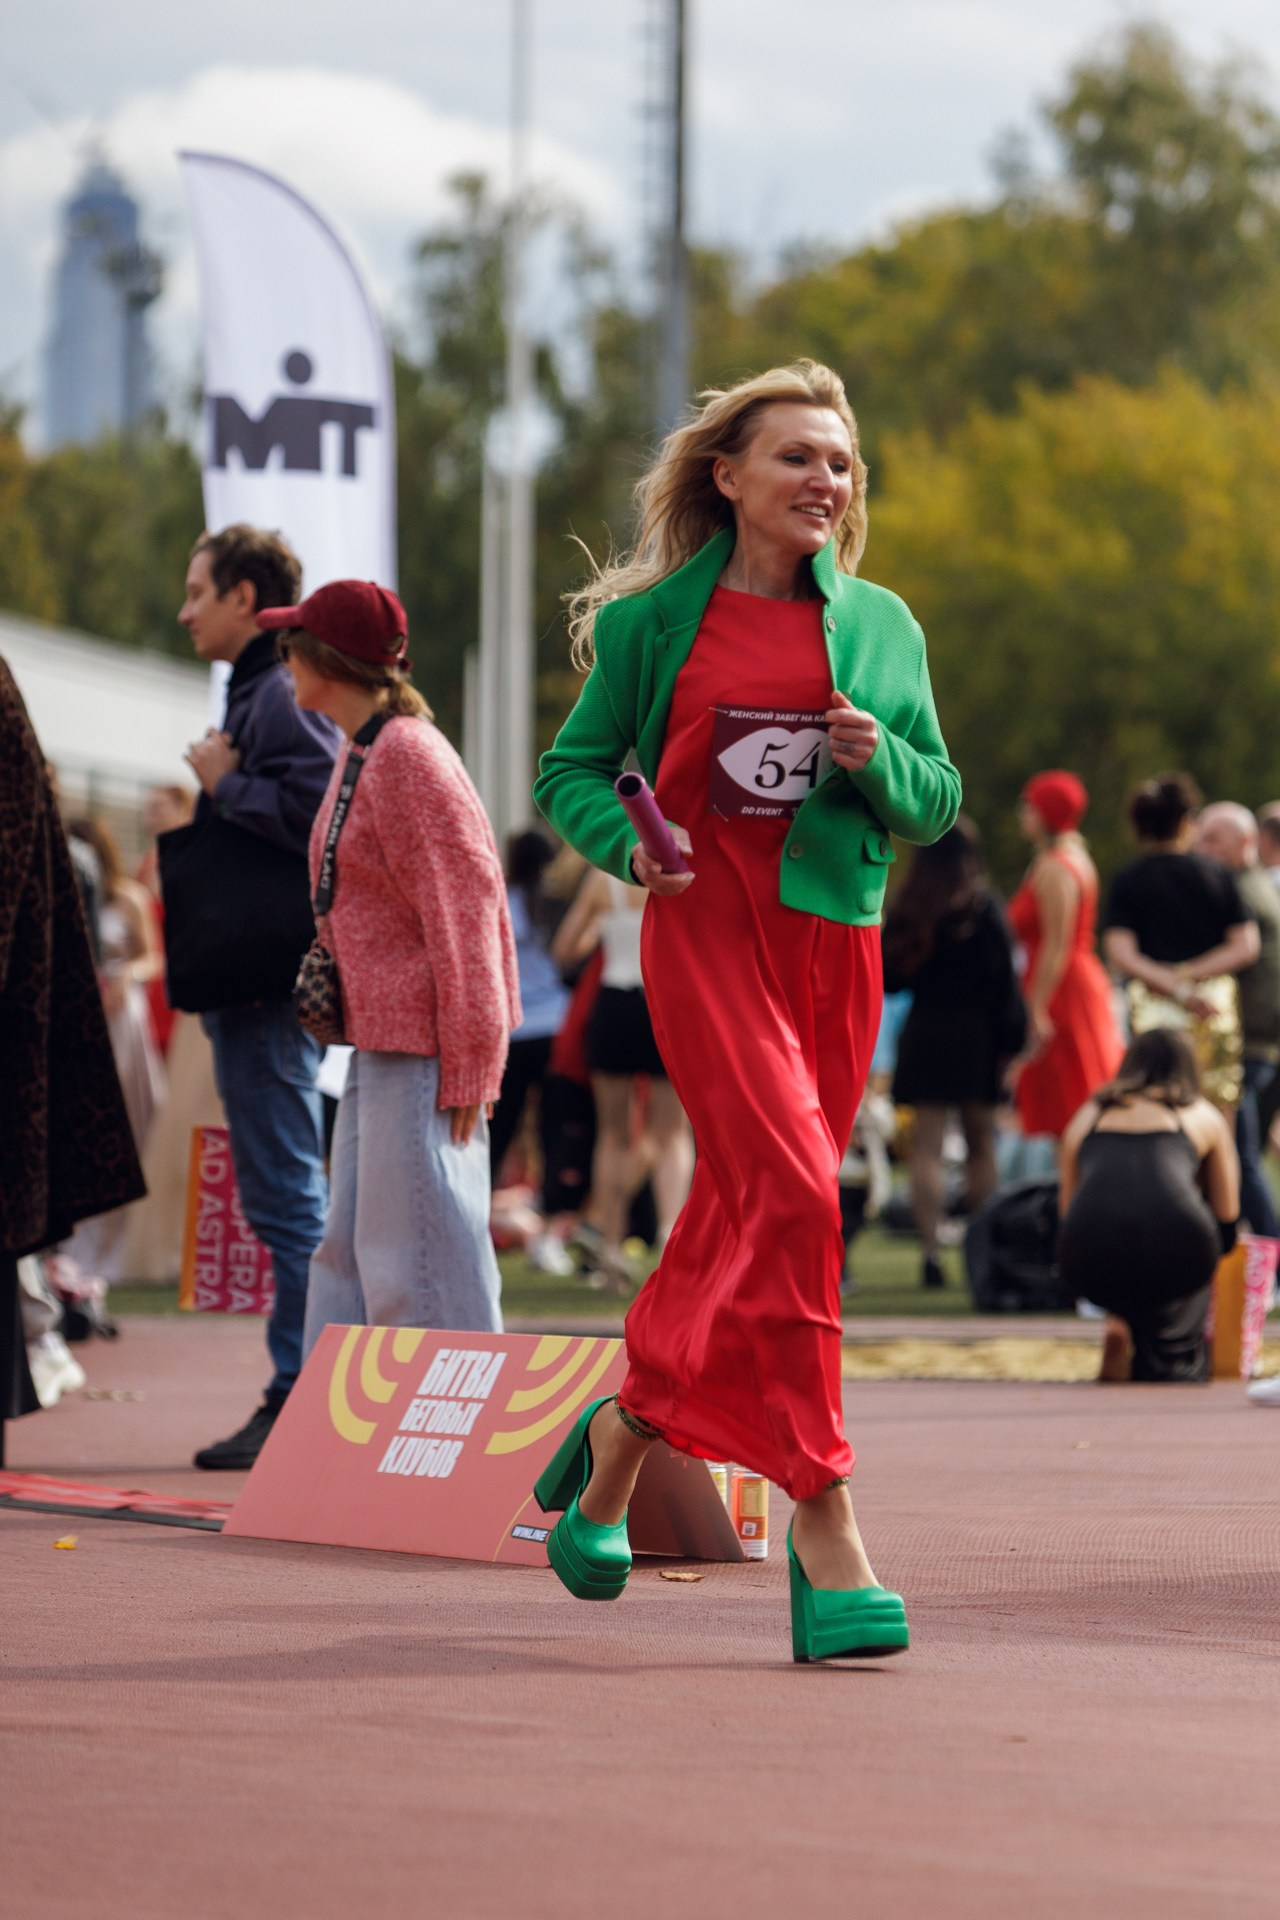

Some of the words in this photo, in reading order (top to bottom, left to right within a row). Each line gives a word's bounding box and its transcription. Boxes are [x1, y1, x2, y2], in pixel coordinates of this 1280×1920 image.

[729, 709, 774, 720] ЖЕНСКИЙ
[774, 713, 800, 722] ЗАБЕГ
[801, 714, 813, 722] НА
[754, 741, 822, 788] 54
[741, 806, 755, 815] DD
[755, 807, 784, 816] EVENT
[200, 1132, 228, 1185] AD
[193, 1192, 226, 1312] ASTRA
[416, 1348, 507, 1399] БИТВА
[398, 1398, 484, 1435] БЕГОВЫХ
[377, 1436, 464, 1478] КЛУБОВ
